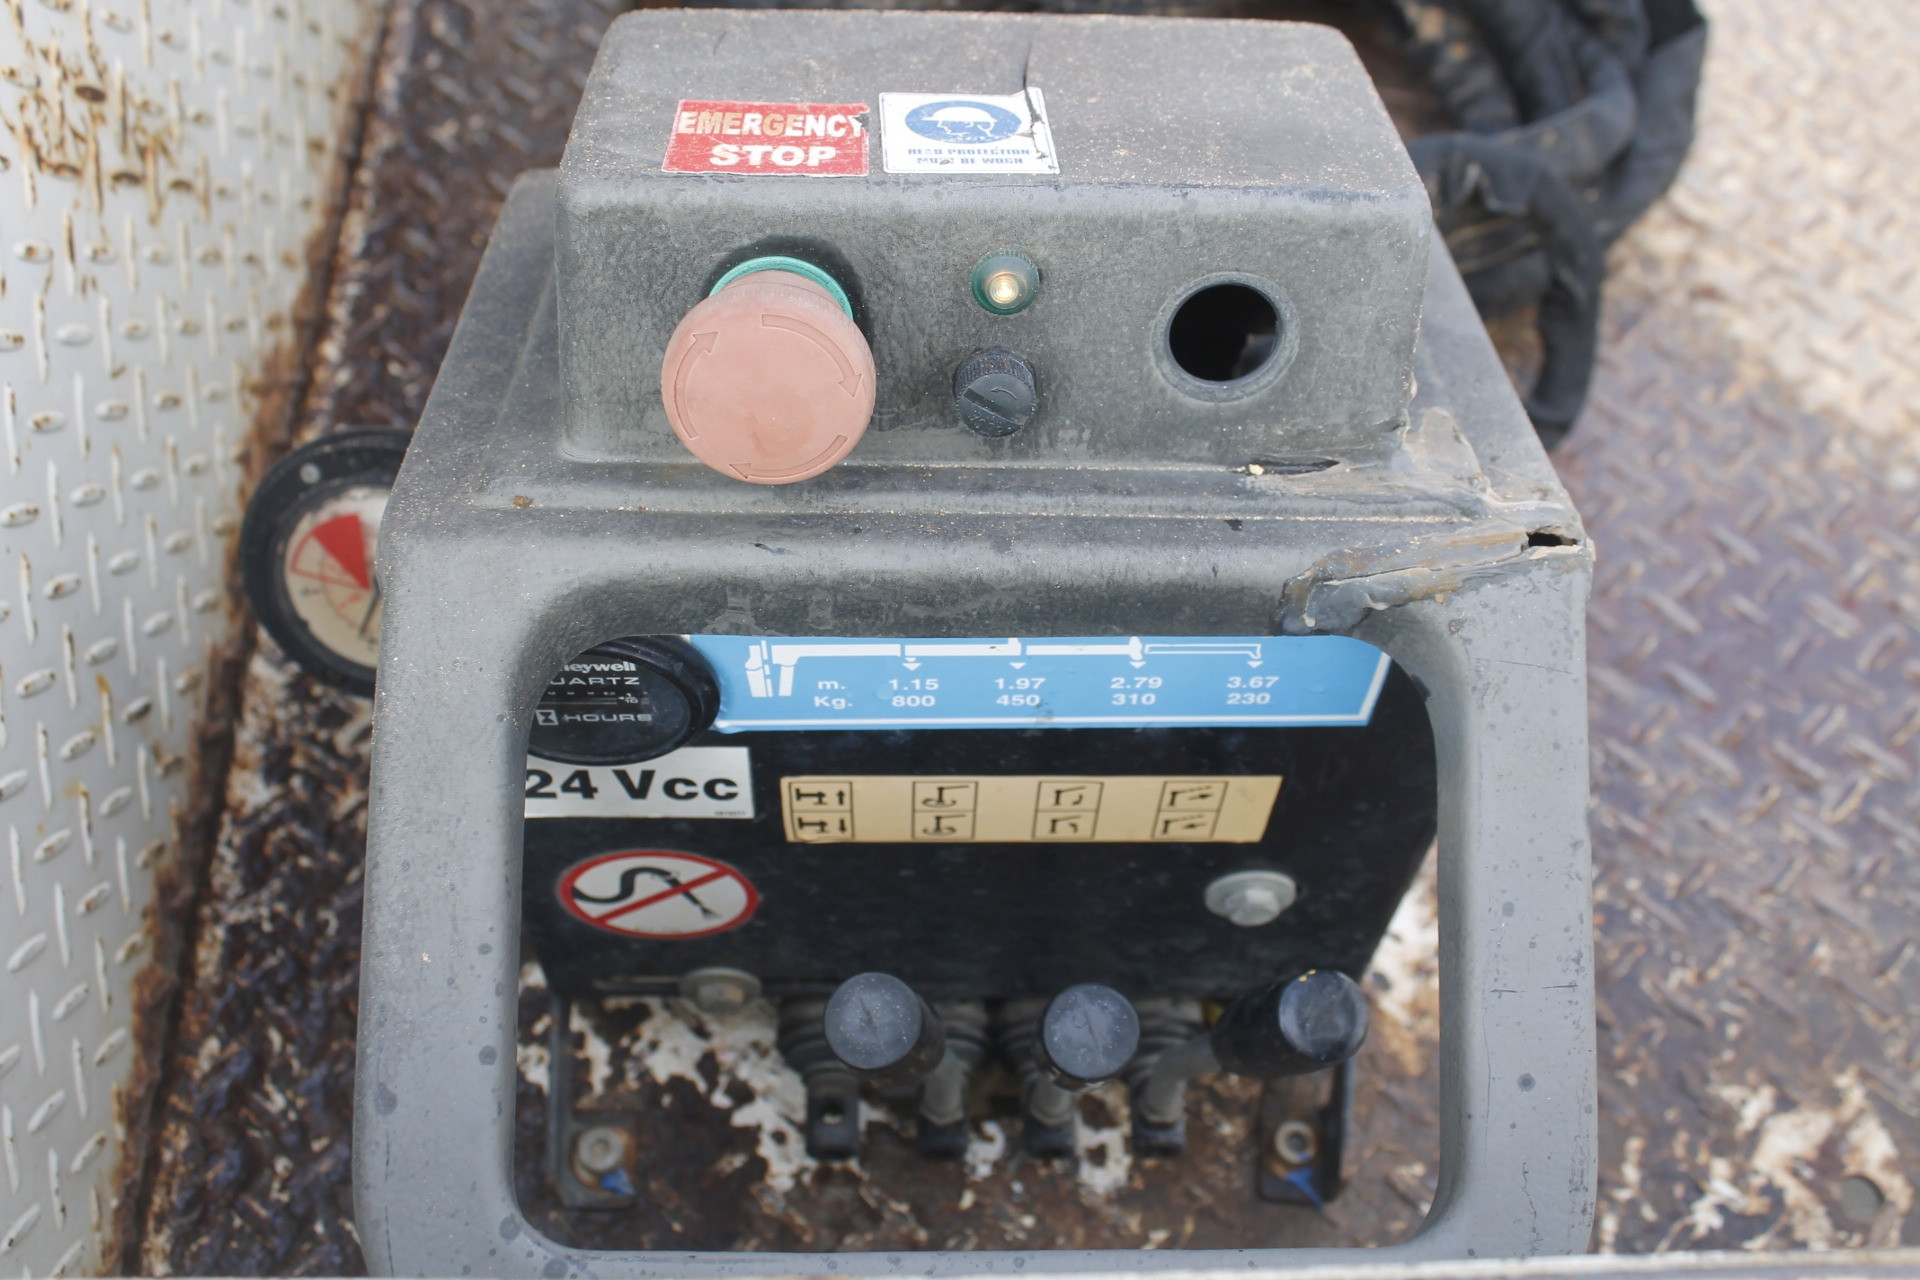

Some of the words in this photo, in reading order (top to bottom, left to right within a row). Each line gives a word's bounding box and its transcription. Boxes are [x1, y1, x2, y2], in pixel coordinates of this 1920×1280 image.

[678, 111, 863, 137] EMERGENCY
[709, 144, 837, 166] STOP
[559, 661, 637, 674] neywell
[550, 677, 640, 685] UARTZ
[817, 680, 846, 690] m.
[889, 679, 939, 691] 1.15
[994, 678, 1046, 690] 1.97
[1110, 677, 1163, 689] 2.79
[1226, 676, 1279, 688] 3.67
[814, 696, 853, 710] Kg.
[892, 695, 936, 707] 800
[996, 694, 1041, 707] 450
[1111, 694, 1156, 705] 310
[1226, 693, 1271, 705] 230
[562, 714, 653, 722] HOURS
[525, 769, 598, 799] 24
[612, 769, 739, 801] Vcc
